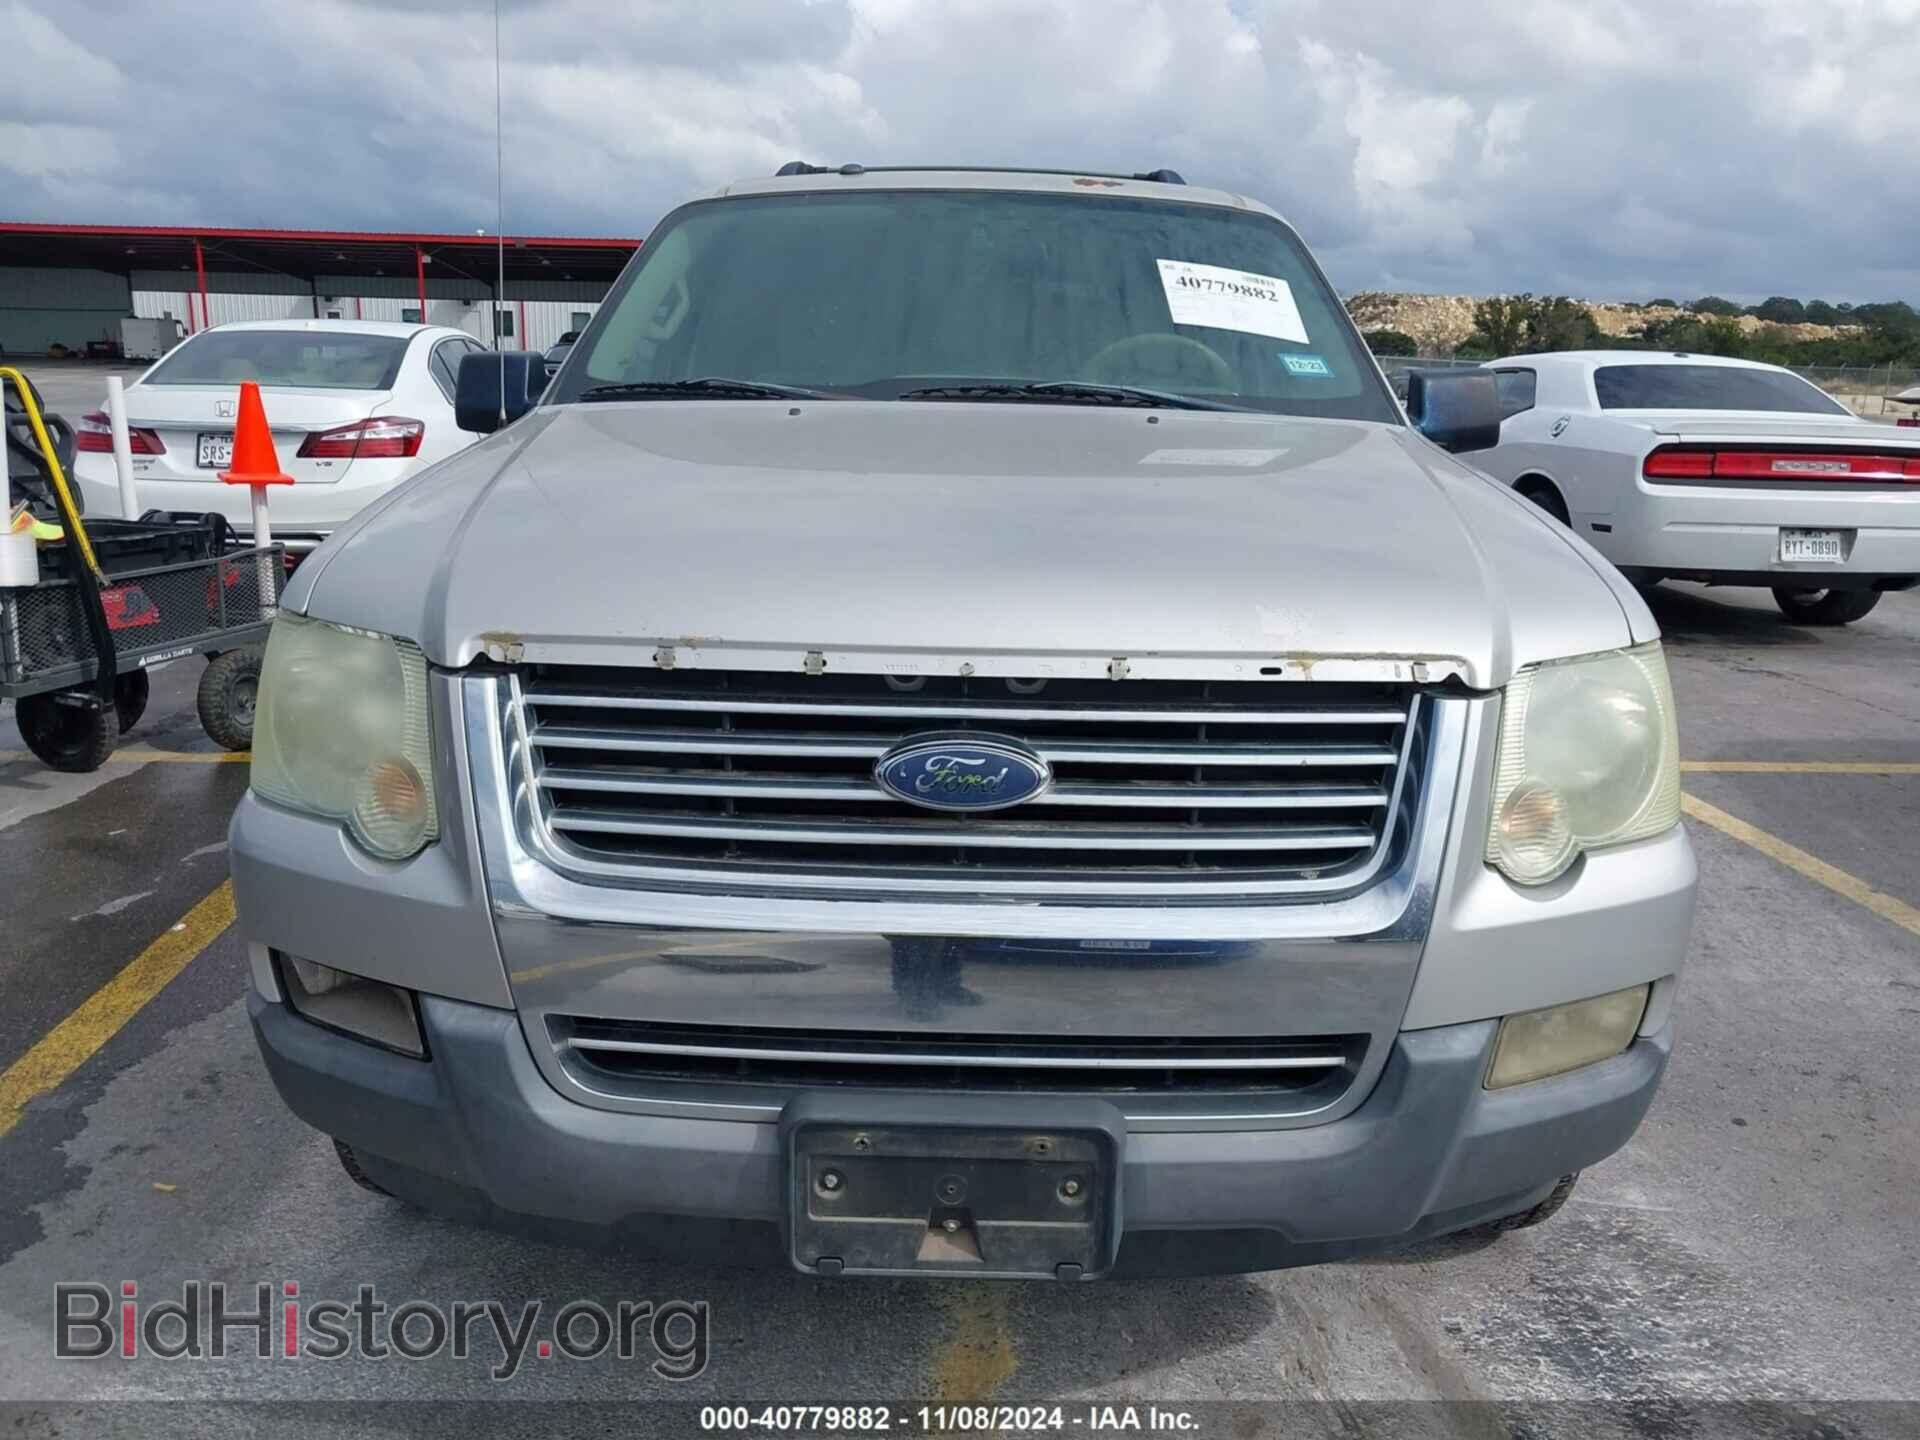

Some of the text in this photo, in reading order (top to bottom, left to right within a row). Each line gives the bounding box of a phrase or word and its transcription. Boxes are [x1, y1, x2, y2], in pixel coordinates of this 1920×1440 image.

[1176, 275, 1279, 302] 40779882
[202, 446, 231, 461] SRS-
[915, 755, 1009, 793] Ford
